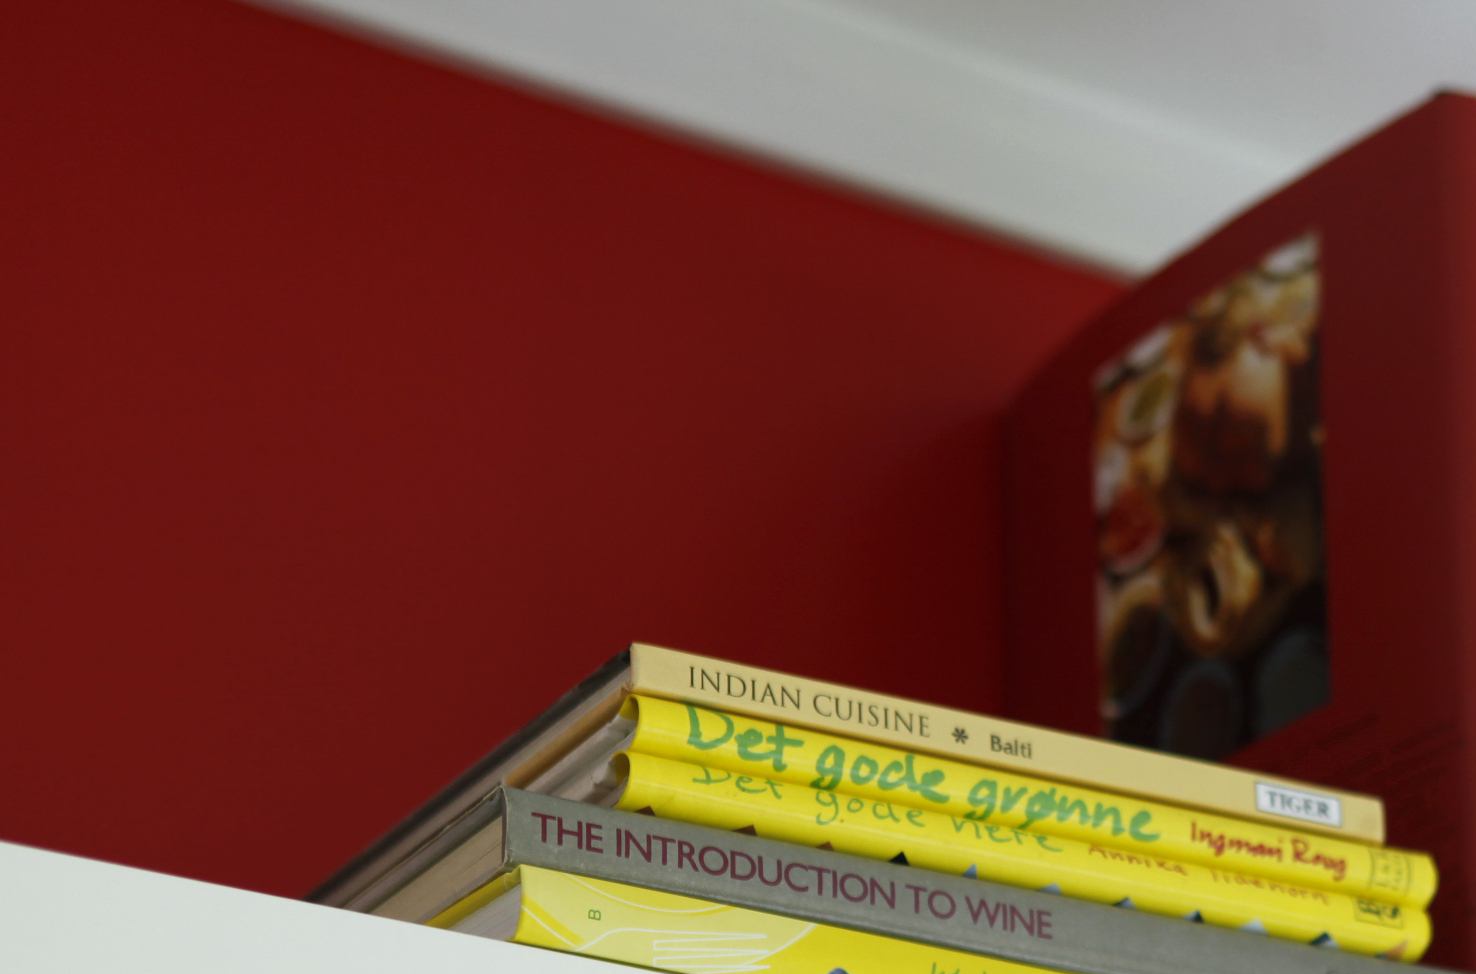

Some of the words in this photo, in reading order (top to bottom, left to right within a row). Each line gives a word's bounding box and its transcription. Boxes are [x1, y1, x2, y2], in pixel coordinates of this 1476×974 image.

[689, 666, 800, 710] INDIAN
[813, 694, 931, 738] CUISINE
[990, 735, 1033, 759] Balti
[686, 704, 804, 773] Det
[813, 745, 950, 804] gode
[964, 777, 1162, 844] grønne
[692, 767, 784, 799] Det
[815, 789, 926, 826] gode
[1265, 790, 1330, 821] TIGER
[531, 811, 604, 855] THE
[616, 828, 897, 910] INTRODUCTION
[906, 885, 957, 921] TO
[967, 895, 1054, 940] WINE
[1191, 820, 1283, 863] Ingmari
